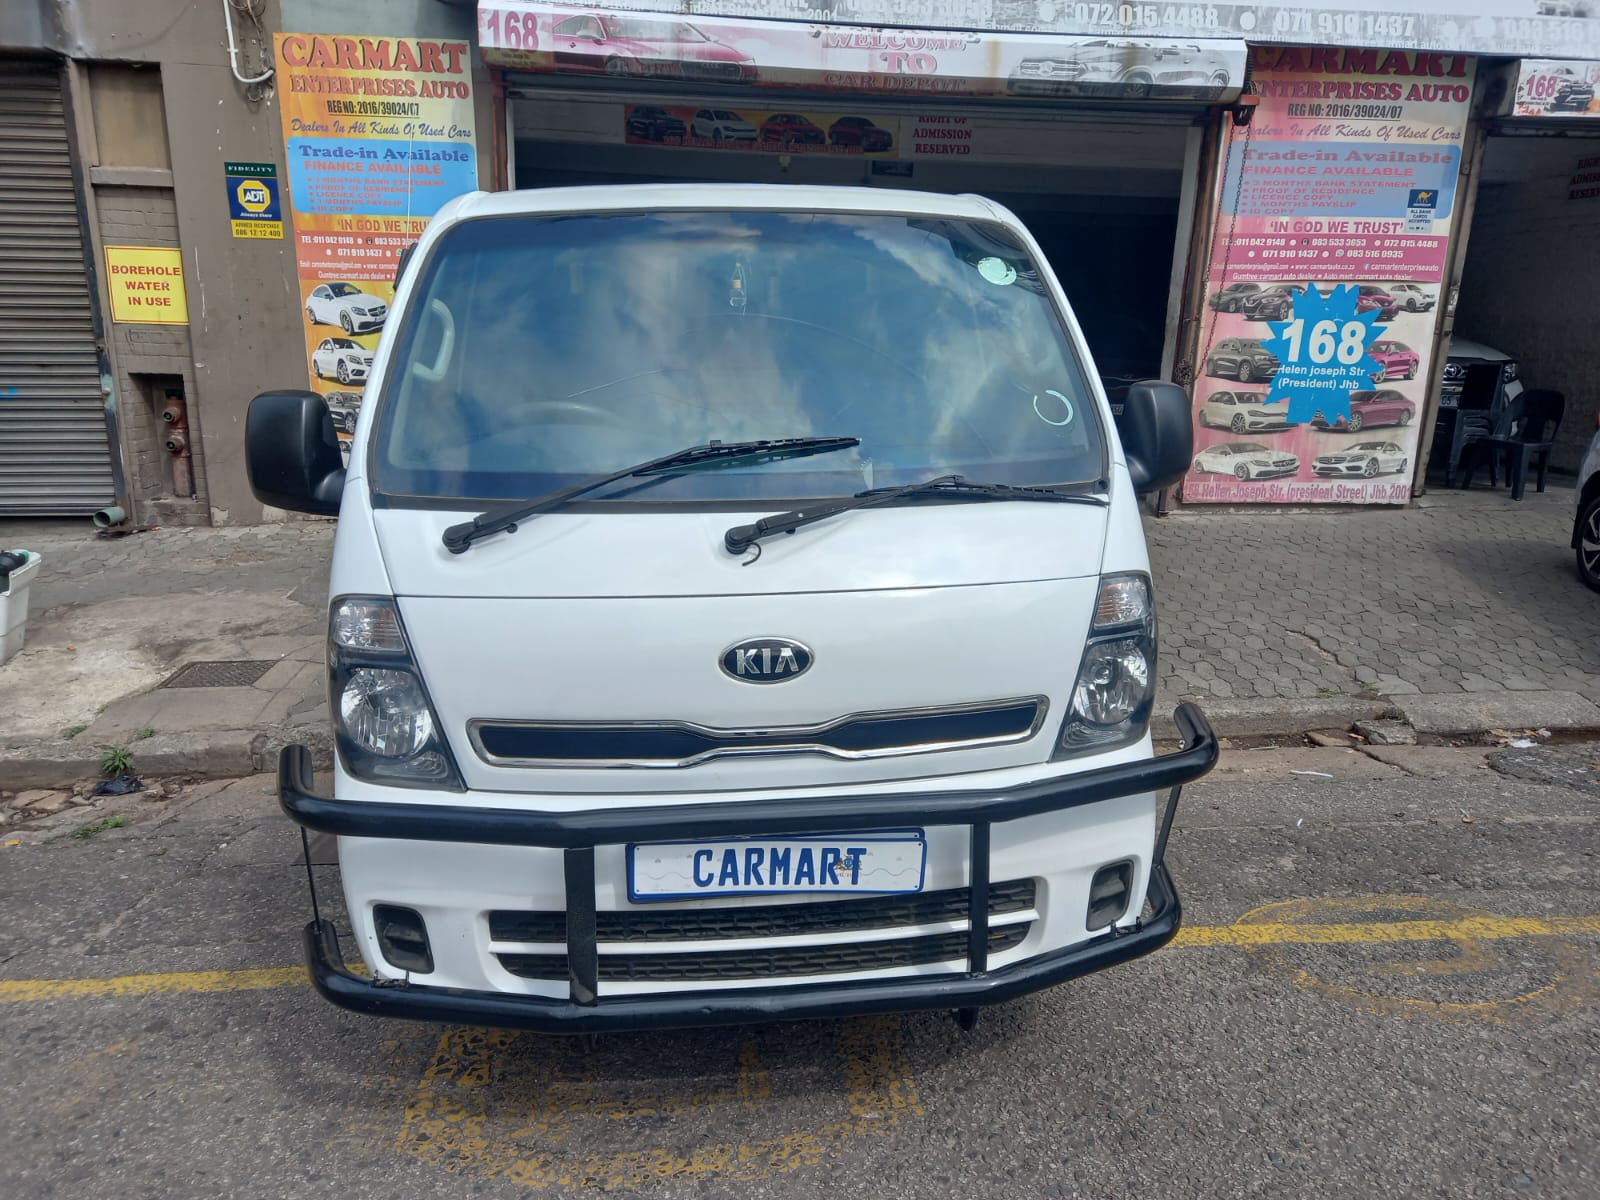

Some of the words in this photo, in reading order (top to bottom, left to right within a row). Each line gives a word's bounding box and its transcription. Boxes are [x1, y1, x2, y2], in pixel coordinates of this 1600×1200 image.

[487, 10, 539, 53] 168
[822, 31, 967, 51] WELCOME
[282, 36, 468, 75] CARMART
[879, 51, 938, 74] TO
[290, 75, 418, 98] ENTERPRISES
[419, 79, 471, 100] AUTO
[824, 73, 876, 88] CAR
[882, 75, 966, 91] DEPOT
[1526, 74, 1557, 98] 168
[1405, 81, 1470, 103] AUTO
[327, 100, 343, 113] REG
[344, 101, 356, 114] NO:
[1288, 104, 1306, 117] REG
[1308, 104, 1325, 117] NO:
[1325, 104, 1403, 119] 2016/39024/07
[291, 118, 330, 133] Dealers
[333, 120, 346, 133] In
[349, 121, 367, 134] All
[370, 122, 399, 135] Kinds
[418, 123, 446, 137] Used
[447, 124, 472, 138] Cars
[912, 128, 973, 139] ADMISSION
[1307, 123, 1330, 136] All
[1336, 124, 1372, 138] Kinds
[1376, 125, 1394, 141] Of
[1397, 126, 1428, 139] Used
[1432, 127, 1462, 141] Cars
[299, 145, 378, 159] Trade-in
[384, 148, 470, 162] Available
[915, 143, 970, 155] RESERVED
[1244, 149, 1339, 161] Trade-in
[1344, 150, 1454, 164] Available
[228, 165, 273, 173] FIDELITY
[305, 160, 364, 173] FINANCE
[368, 162, 442, 175] AVAILABLE
[1244, 165, 1316, 176] FINANCE
[1322, 166, 1414, 177] AVAILABLE
[1263, 179, 1312, 187] MONTHS
[1315, 180, 1346, 188] BANK
[1351, 180, 1417, 189] STATEMENT
[1311, 187, 1376, 196] RESIDENCE
[244, 190, 265, 202] ADT
[1251, 193, 1300, 201] LICENCE
[1303, 194, 1334, 202] COPY
[1312, 201, 1358, 209] PAYSLIP
[356, 219, 381, 232] GOD
[384, 220, 402, 232] WE
[1293, 221, 1323, 233] GOD
[1328, 222, 1349, 233] WE
[1262, 250, 1278, 258] 071
[111, 265, 182, 276] BOREHOLE
[125, 281, 170, 291] WATER
[128, 296, 142, 306] IN
[145, 297, 172, 307] USE
[1282, 318, 1366, 365] 168
[1278, 377, 1337, 390] (President)
[1340, 380, 1360, 390] Jhb
[1336, 484, 1368, 501] Street)
[1370, 484, 1387, 499] Jhb
[735, 647, 799, 674] KIA
[693, 847, 867, 888] CARMART
